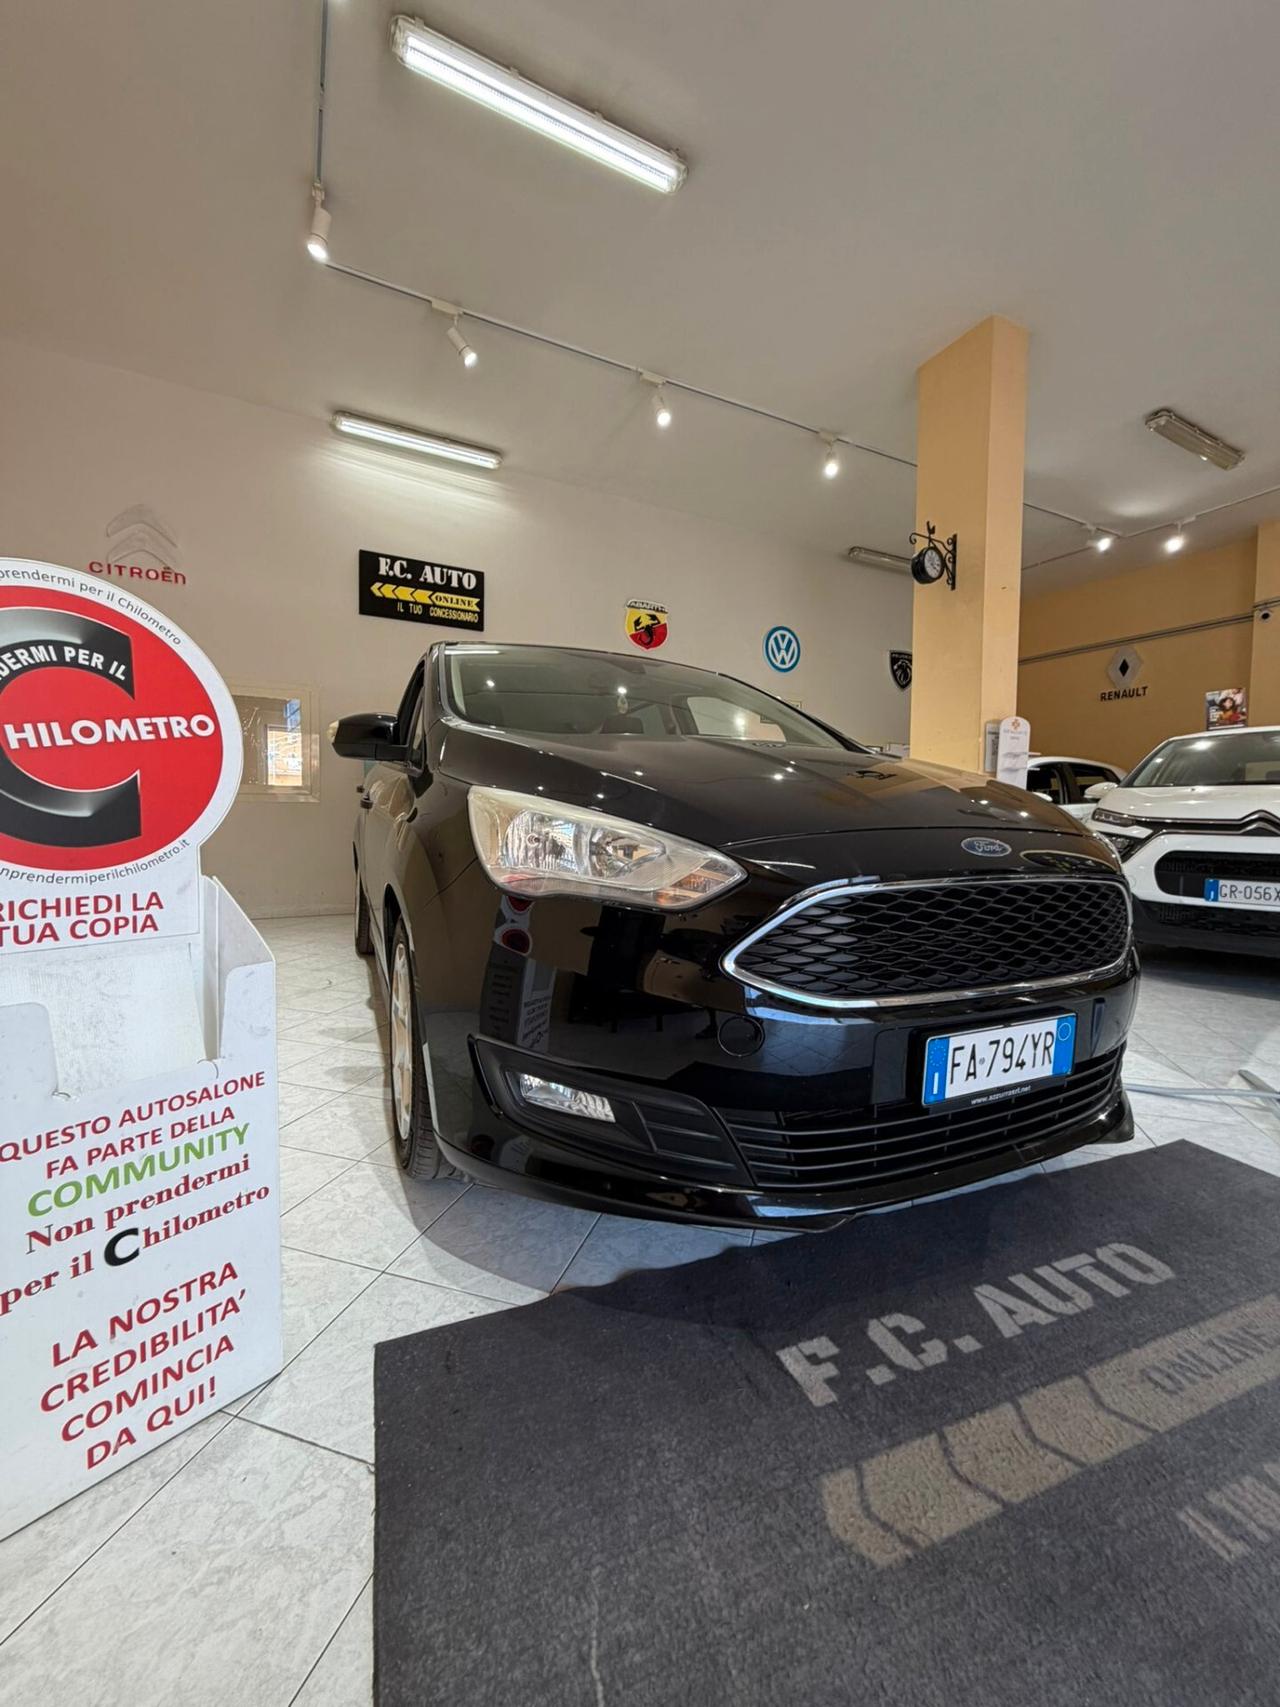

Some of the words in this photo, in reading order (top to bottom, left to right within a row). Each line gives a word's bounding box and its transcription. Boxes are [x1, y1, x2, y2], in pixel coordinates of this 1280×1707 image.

[79, 583, 103, 597] per
[106, 591, 115, 602] il
[117, 597, 181, 645] Chilometro
[397, 602, 404, 612] IL
[409, 603, 423, 614] TUO
[429, 606, 479, 623] CONCESSIONARIO
[419, 565, 477, 590] AUTO
[435, 594, 475, 608] ONLINE
[63, 645, 105, 670] PER
[108, 660, 126, 681] IL
[1100, 686, 1148, 702] RENAULT
[0, 922, 60, 947] TUA
[69, 914, 159, 940] COPIA
[131, 891, 164, 912] LA
[0, 1116, 111, 1162] QUESTO
[118, 1071, 266, 1128] AUTOSALONE
[46, 1155, 78, 1180] FA
[87, 1128, 162, 1166] PARTE
[170, 1106, 235, 1139] DELLA
[26, 1216, 95, 1254] Non
[105, 1154, 251, 1231] prendermi
[27, 1122, 250, 1218] COMMUNITY
[0, 1269, 60, 1316] per
[70, 1250, 94, 1280] il
[103, 1186, 270, 1267] Chilometro
[52, 1329, 98, 1368] LA
[109, 1262, 238, 1340] NOSTRA
[974, 1242, 1176, 1339] AUTO
[61, 1335, 235, 1442] COMINCIA
[86, 1427, 137, 1470] DA
[146, 1376, 216, 1433] QUI!
